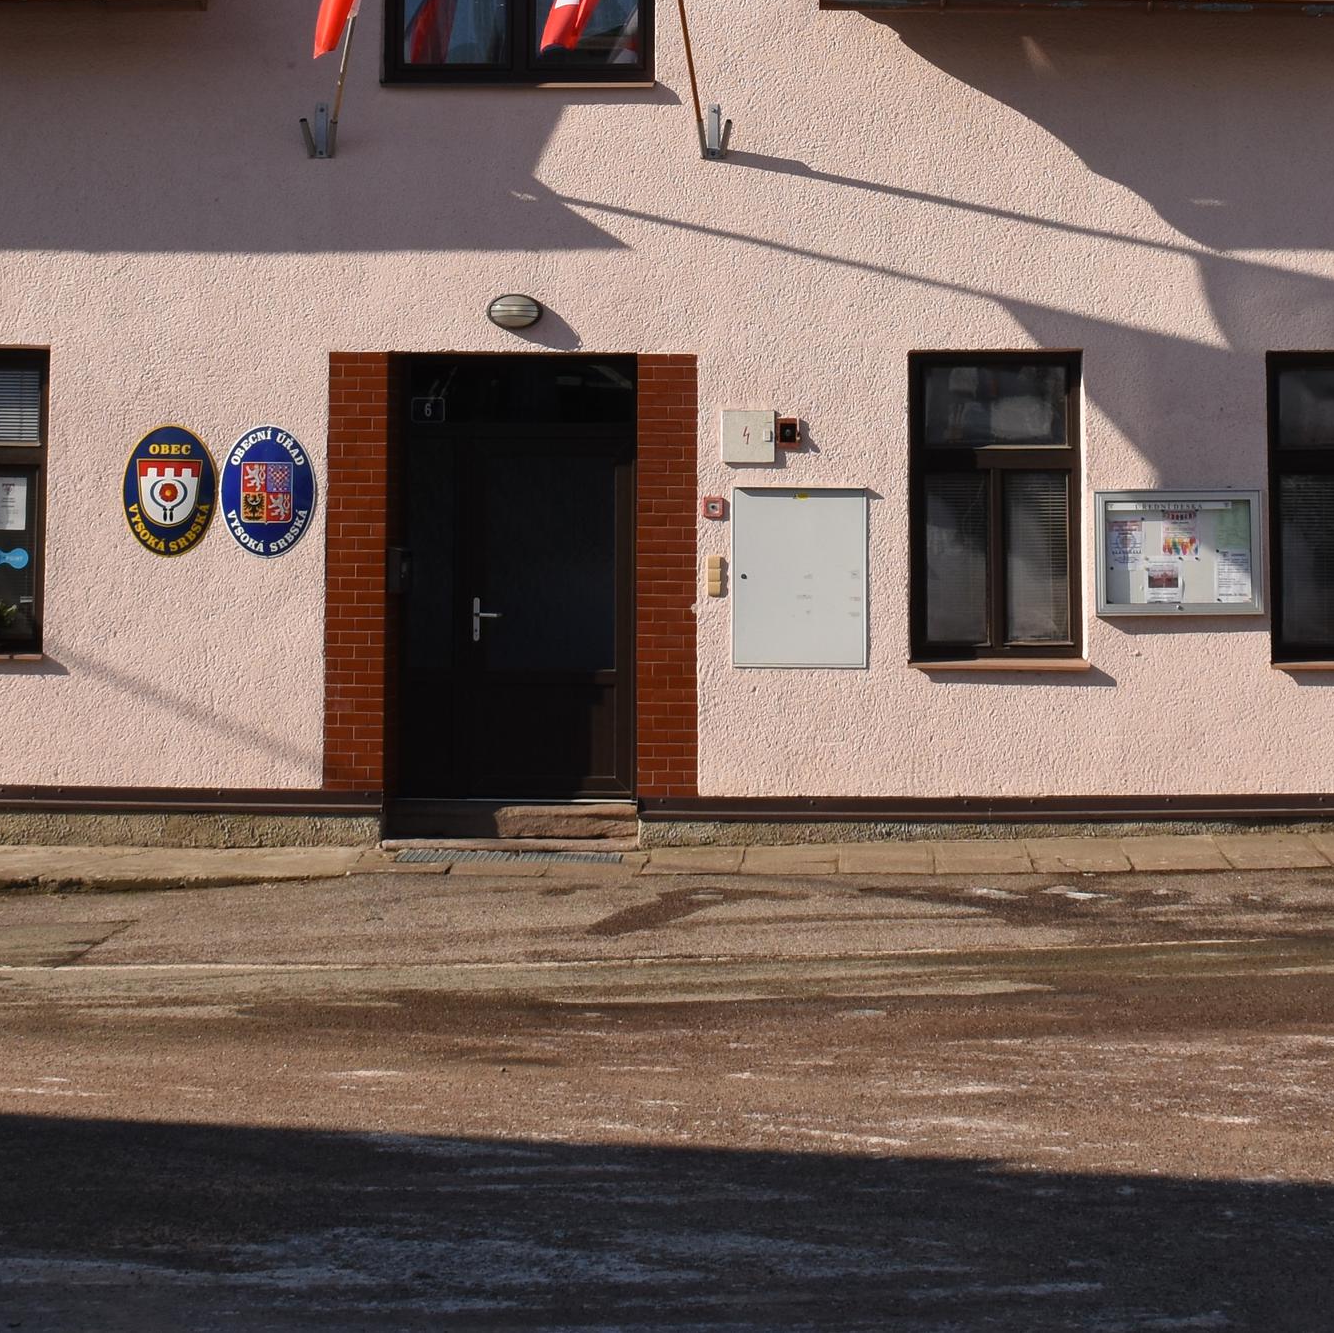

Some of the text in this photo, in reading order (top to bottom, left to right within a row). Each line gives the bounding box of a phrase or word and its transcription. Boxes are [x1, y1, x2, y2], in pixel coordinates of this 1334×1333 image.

[424, 403, 432, 417] 6
[148, 444, 191, 455] OBEC
[230, 427, 305, 466] OBECNÍ ÚŘAD
[127, 501, 210, 552] VYSOKÁ SRBSKÁ
[226, 507, 308, 553] VYSOKÁ SRBSKÁ
